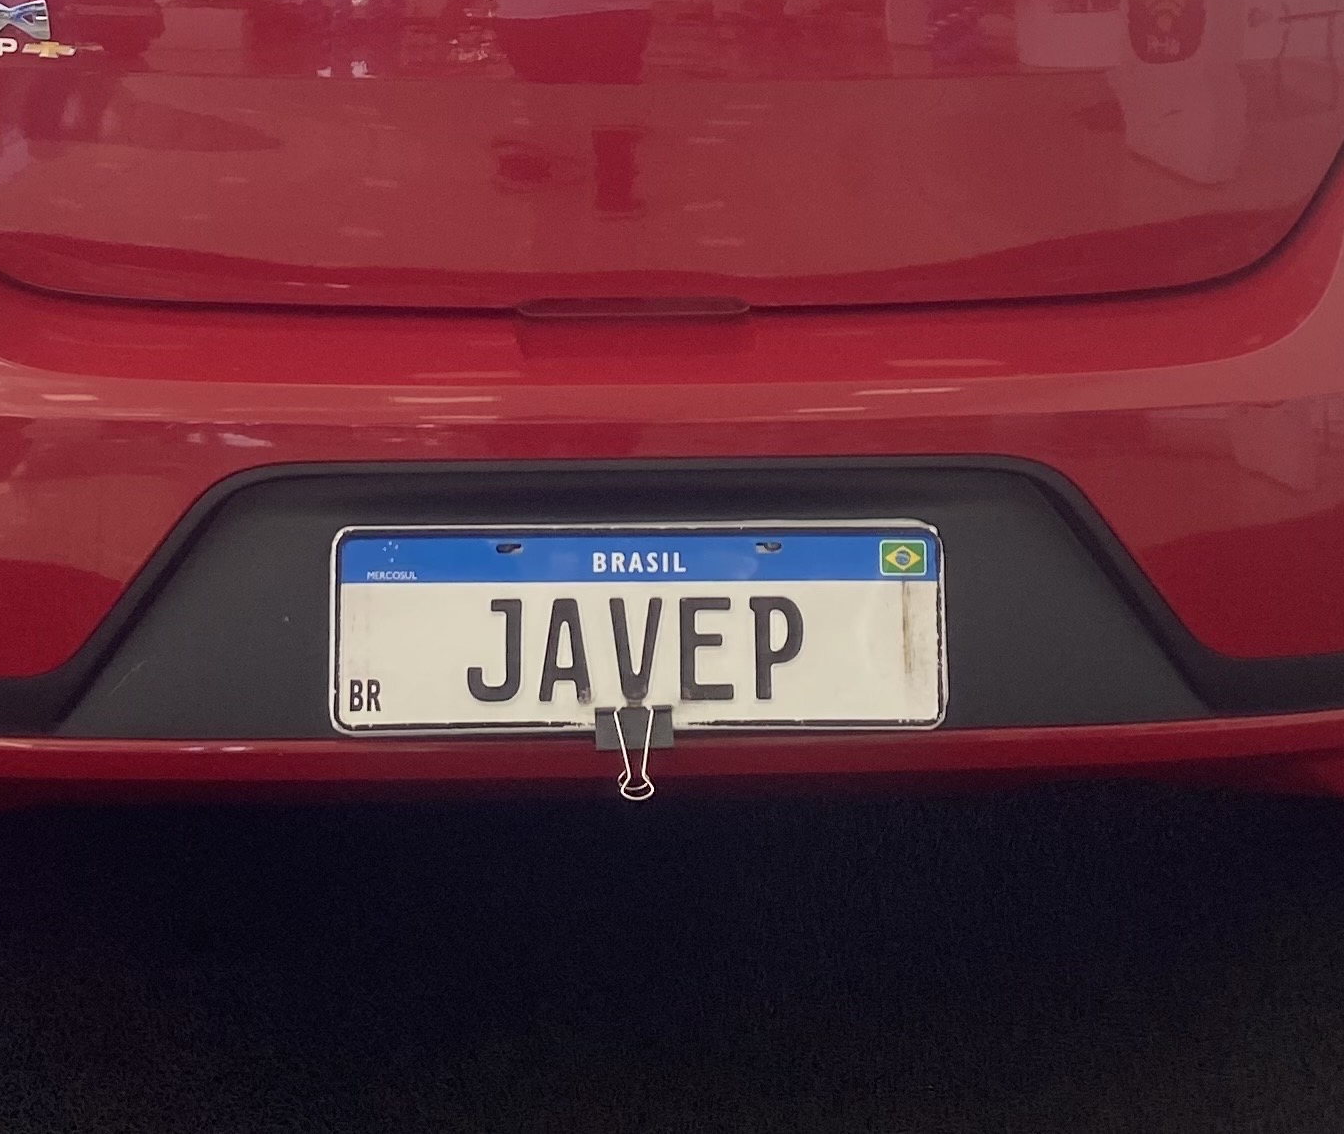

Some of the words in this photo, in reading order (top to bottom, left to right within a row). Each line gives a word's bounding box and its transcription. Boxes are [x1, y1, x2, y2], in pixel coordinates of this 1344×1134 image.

[367, 570, 418, 580] MERCOSUL
[592, 552, 687, 573] BRASIL
[467, 596, 804, 704] JAVEP
[349, 679, 381, 712] BR
